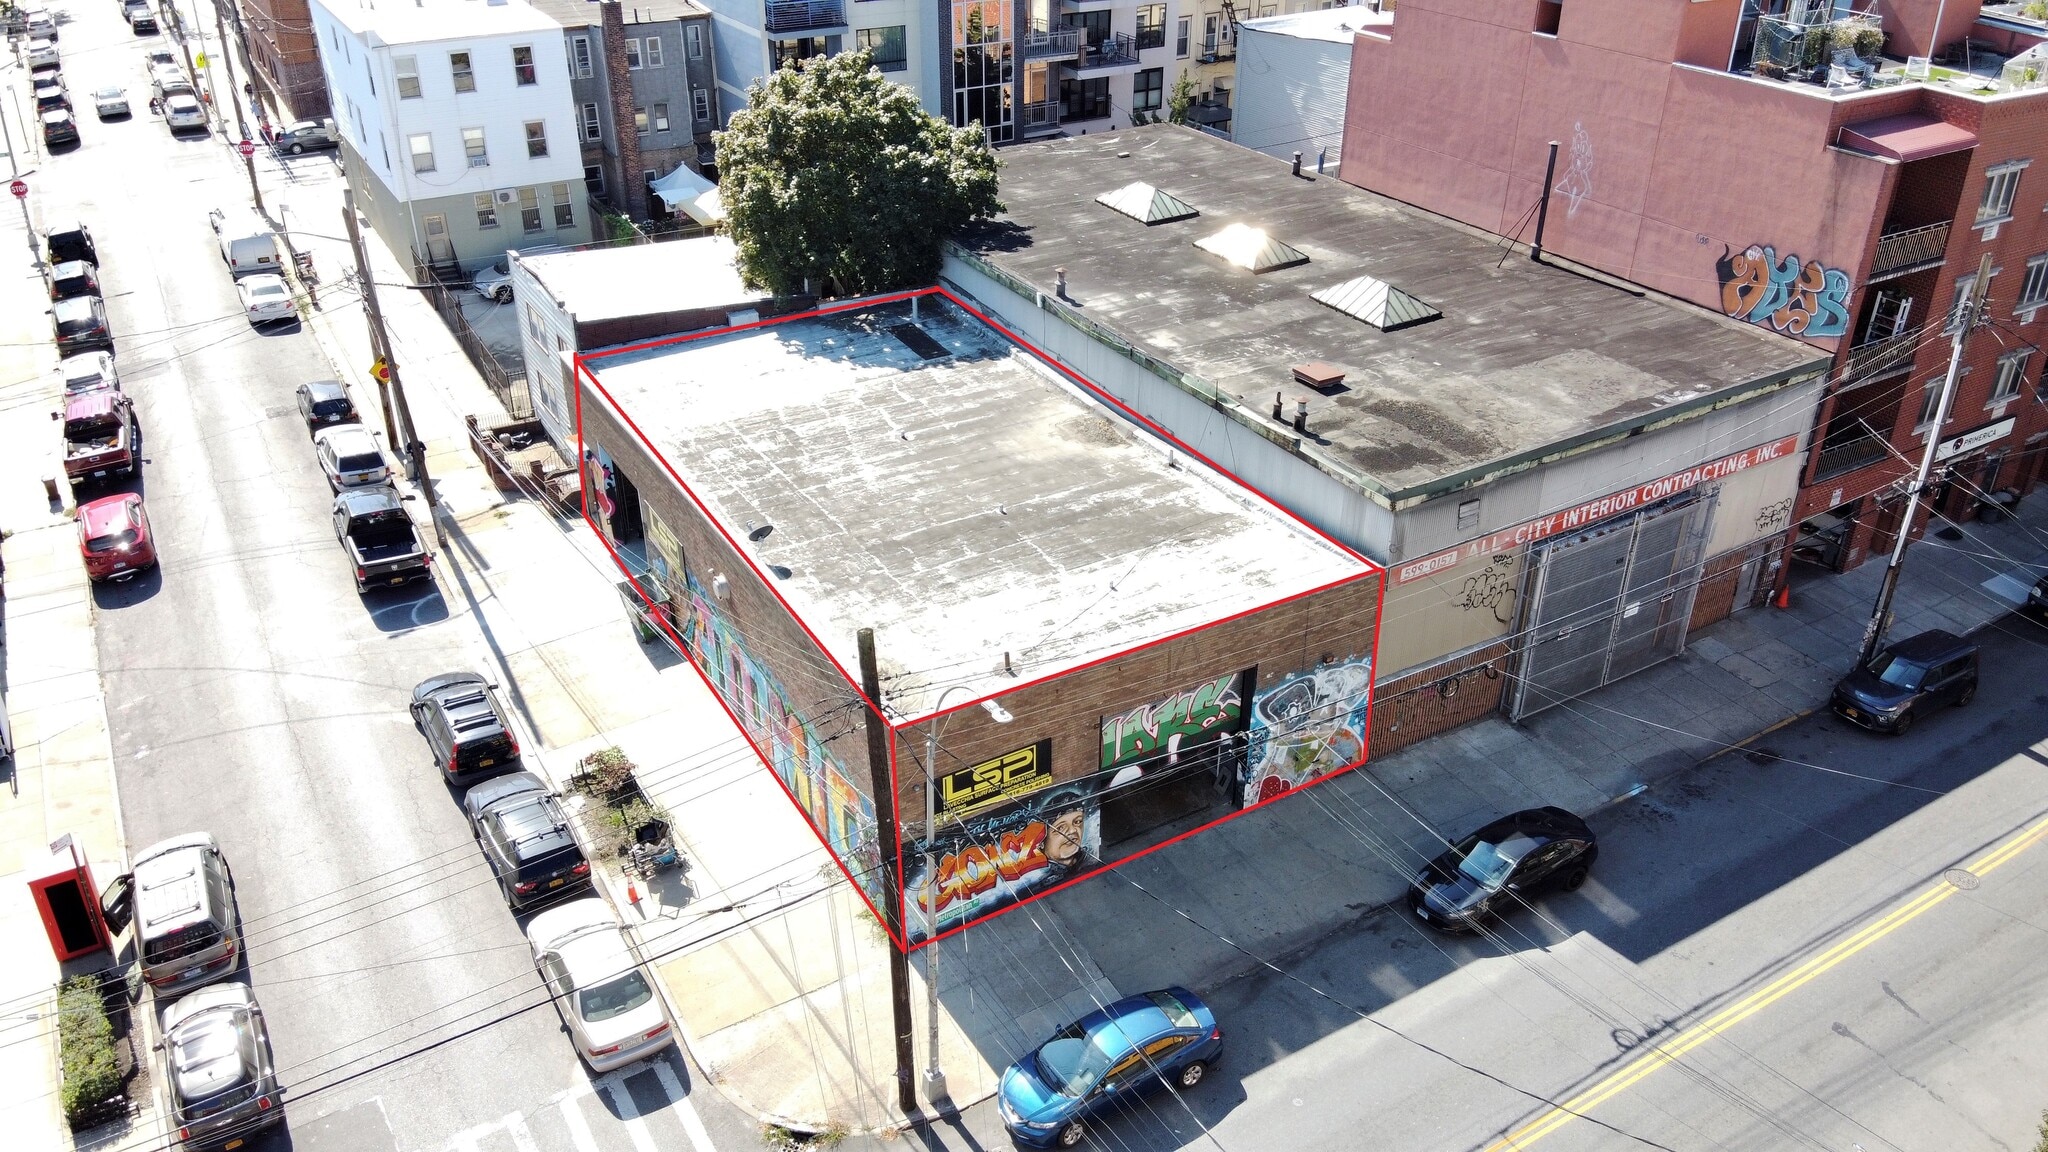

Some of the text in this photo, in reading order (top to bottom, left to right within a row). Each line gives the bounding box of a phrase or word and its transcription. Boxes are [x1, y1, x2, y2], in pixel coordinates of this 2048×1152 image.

[1963, 429, 1996, 447] PRIMERICA
[1562, 490, 1638, 527] INTERIOR
[1755, 443, 1782, 464] INC.
[1403, 554, 1453, 580] 599-0157
[943, 745, 1036, 802] LSP
[974, 785, 1000, 799] SURFACE
[1000, 772, 1036, 790] PREPARATION
[937, 902, 972, 922] Metropoltan
